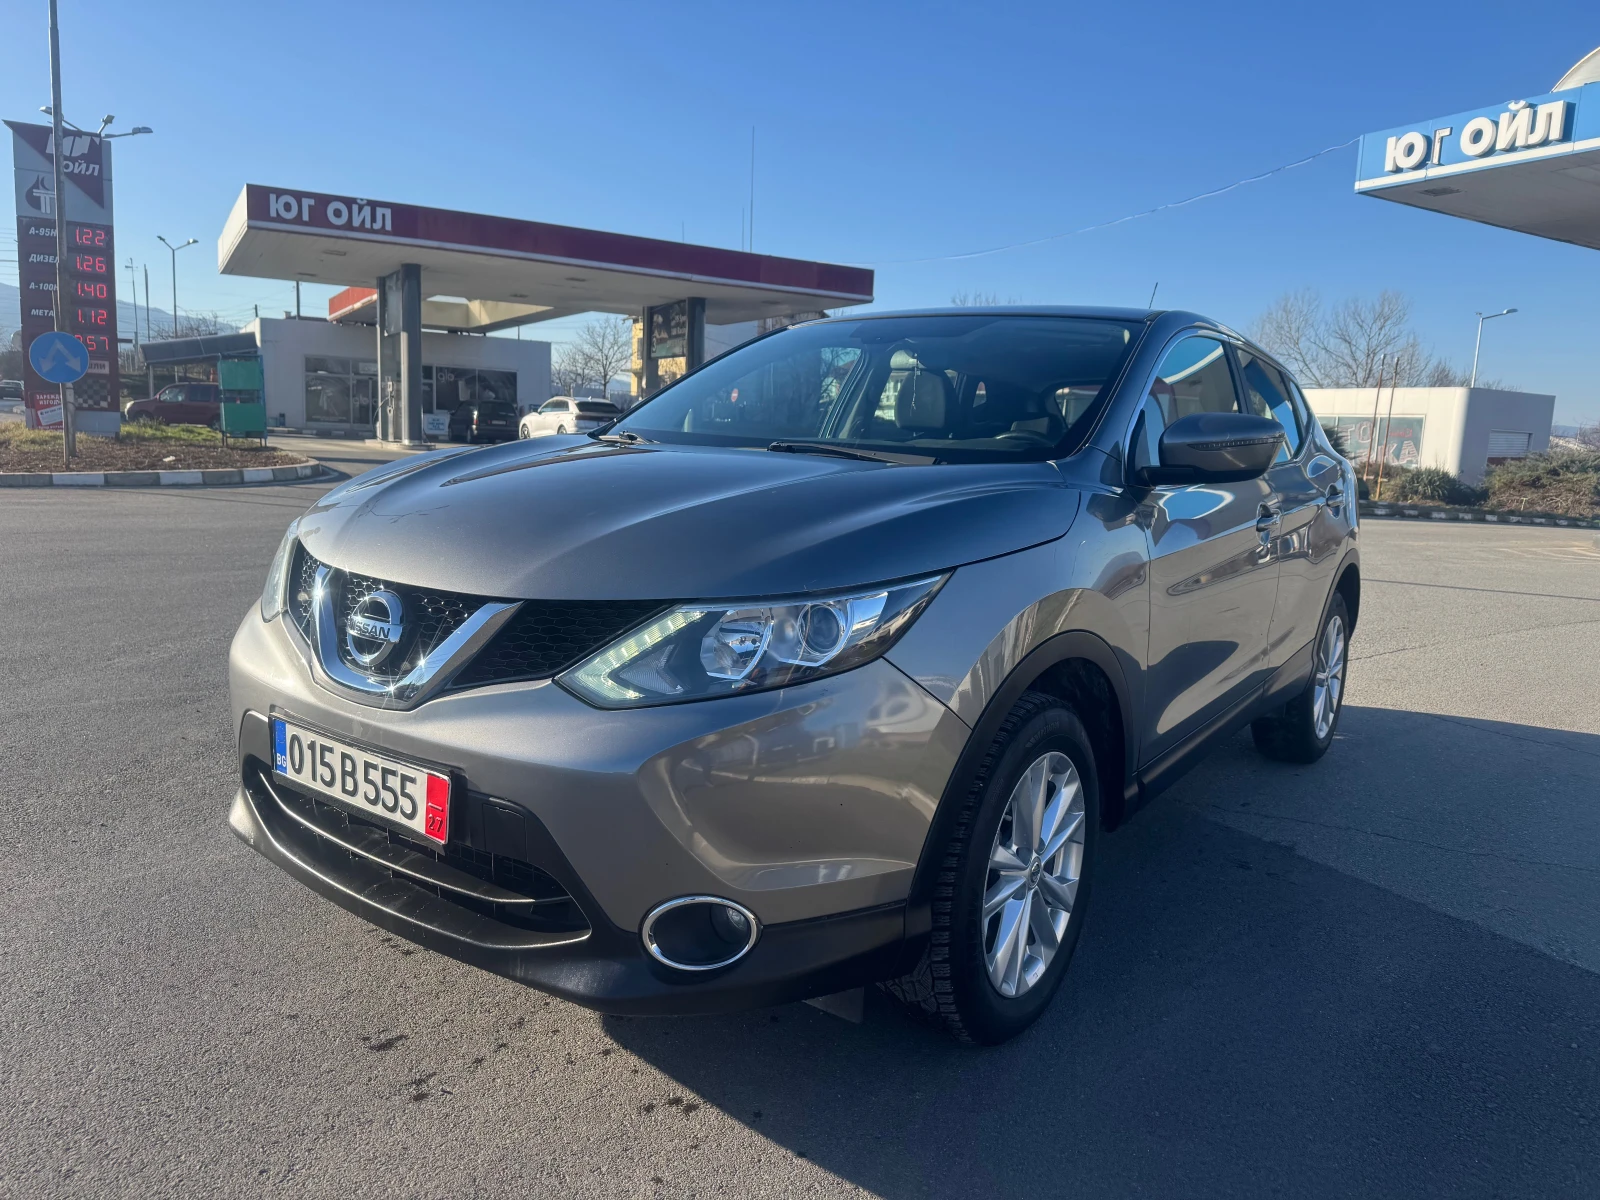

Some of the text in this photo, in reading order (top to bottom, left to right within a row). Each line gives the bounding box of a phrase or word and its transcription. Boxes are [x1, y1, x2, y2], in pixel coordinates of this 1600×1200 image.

[1384, 100, 1568, 173] ЮГ ОЙЛ
[63, 160, 99, 176] ОЙЛ
[269, 193, 392, 232] ЮГ ОЙЛ
[75, 228, 105, 246] 1.22
[76, 255, 106, 273] 1.26
[77, 282, 107, 299] 1.40
[78, 309, 107, 325] 1.12
[347, 616, 391, 639] NISSAN
[276, 752, 287, 767] BG
[427, 813, 444, 833] 27
